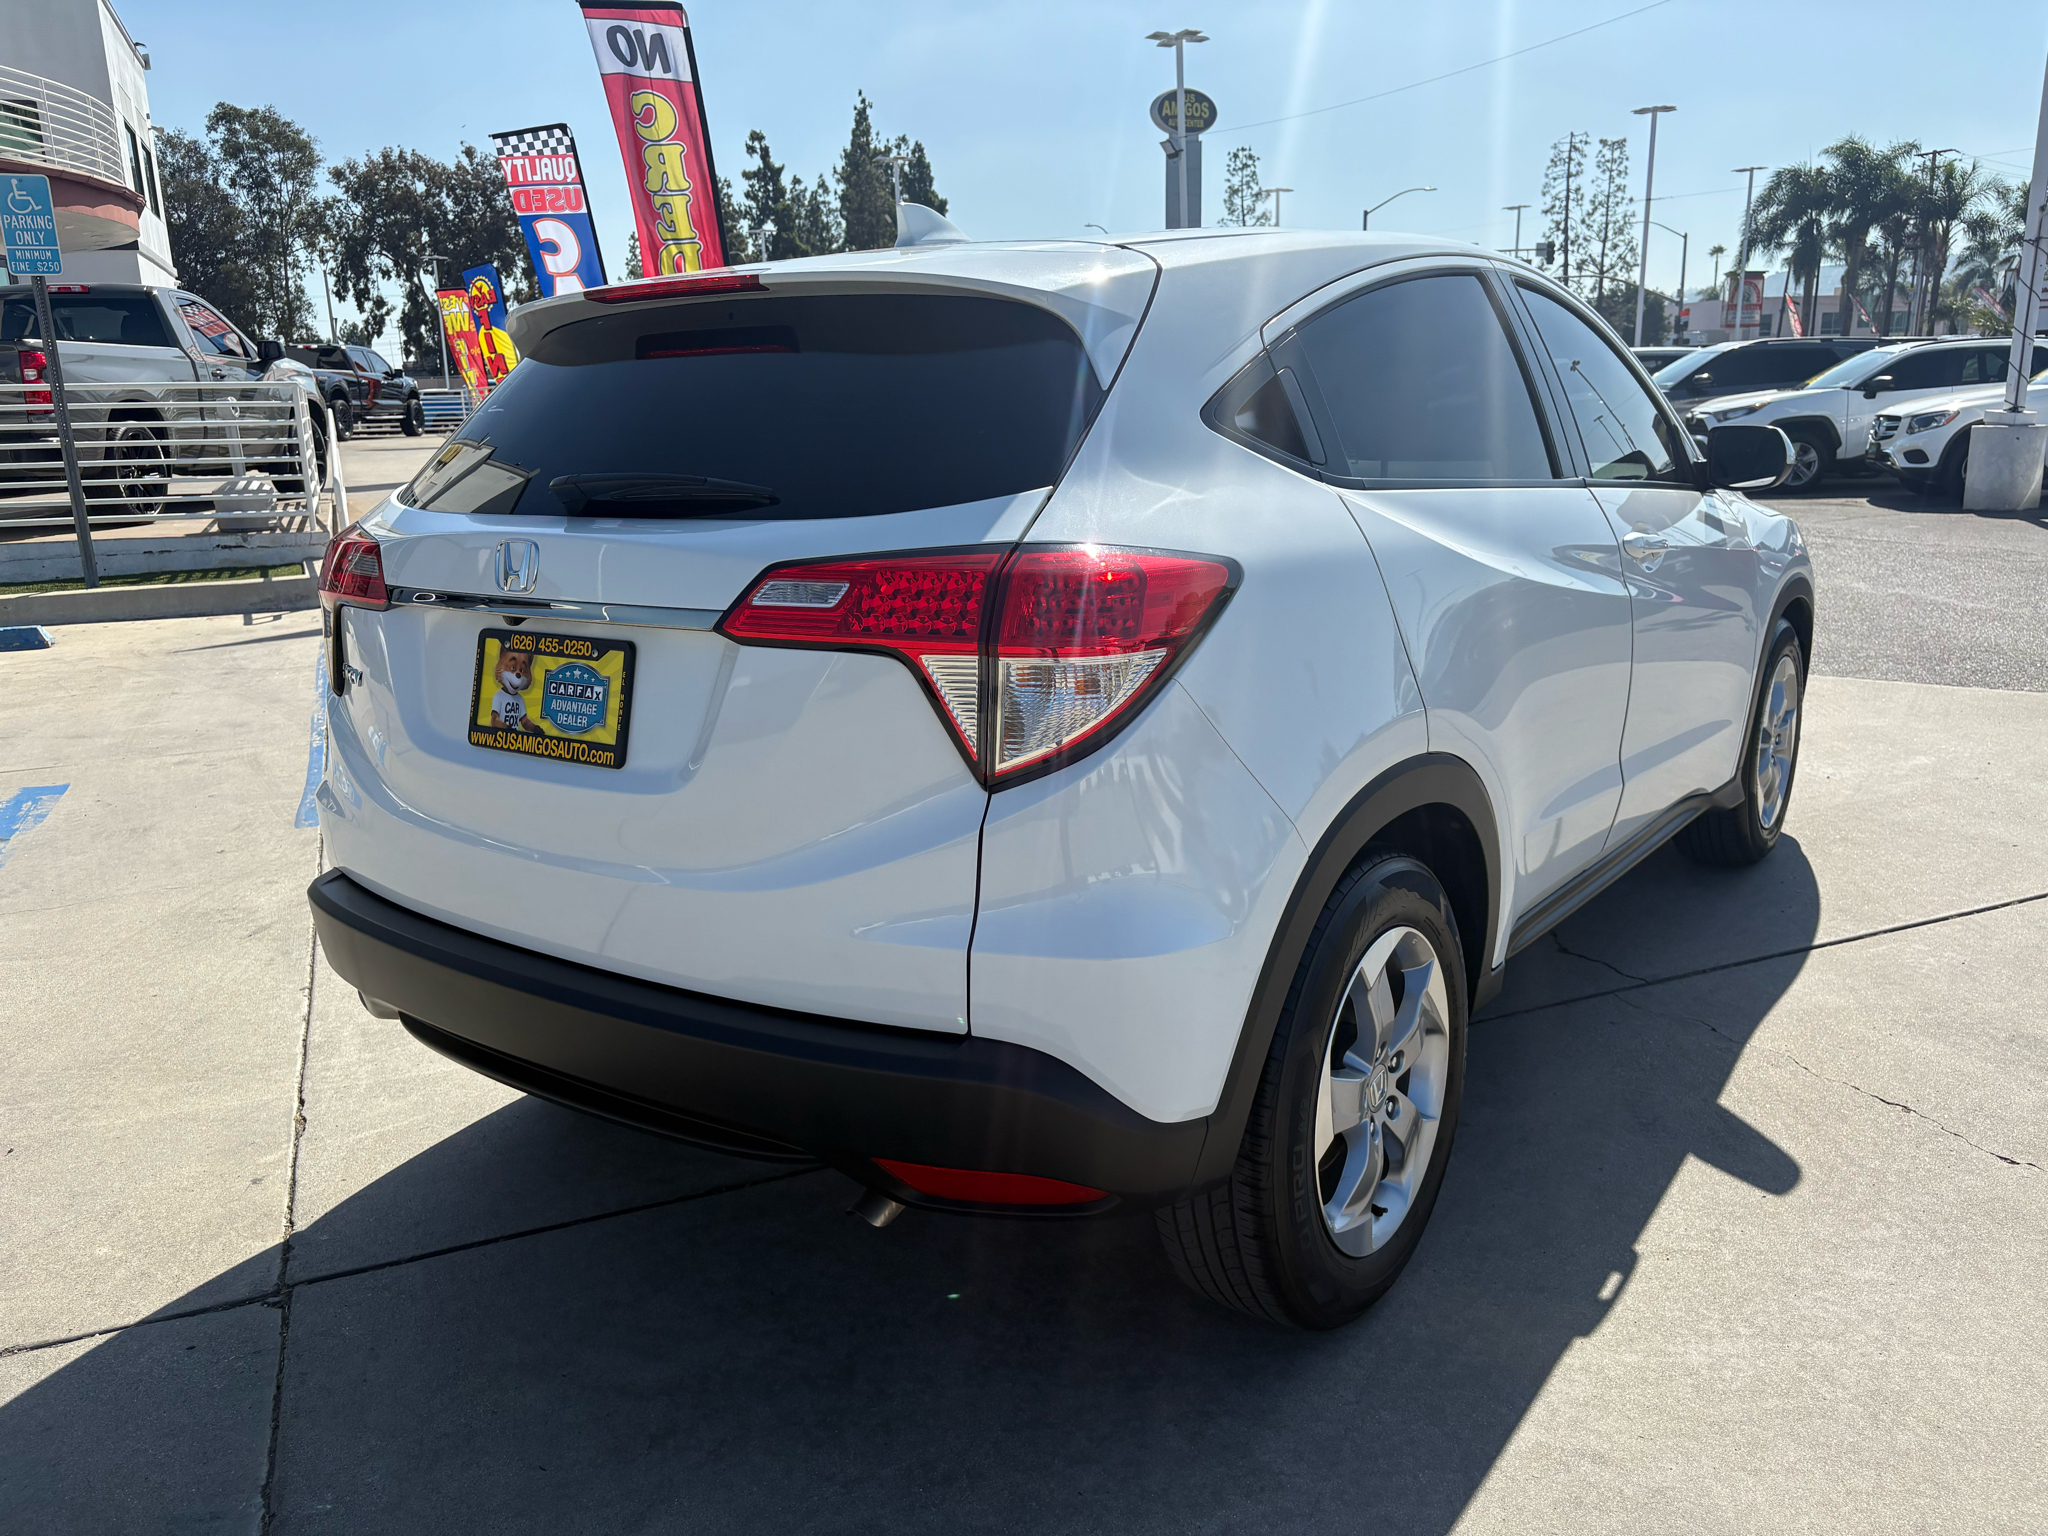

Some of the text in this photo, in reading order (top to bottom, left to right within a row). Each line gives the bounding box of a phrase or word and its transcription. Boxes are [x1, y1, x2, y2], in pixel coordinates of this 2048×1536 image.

[1162, 100, 1210, 118] AMGOS
[3, 215, 52, 229] PARKING
[15, 231, 45, 245] ONLY
[15, 250, 52, 260] MINIMUM
[11, 261, 60, 272] FINE $250
[510, 633, 592, 656] (626) 455-0250
[550, 683, 602, 701] CARFAX
[504, 701, 520, 714] CAR
[550, 698, 598, 716] ADVANTAGE
[617, 671, 627, 731] EL MONTE
[504, 714, 519, 727] FOX
[556, 712, 588, 728] DEALER
[470, 731, 615, 765] www.SUSAMIGOSAUTO.com
